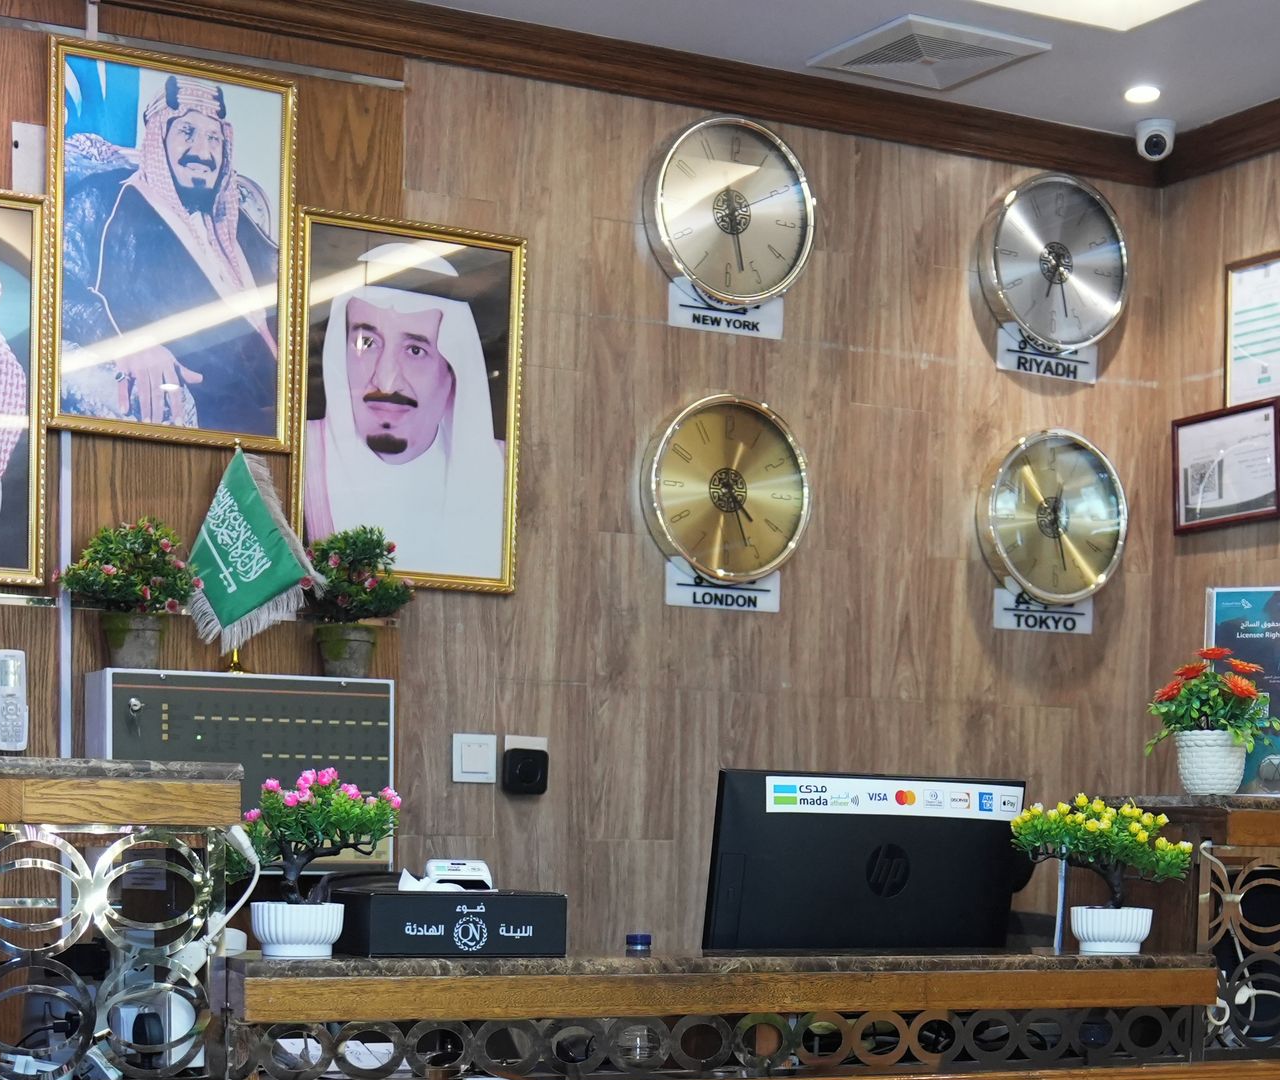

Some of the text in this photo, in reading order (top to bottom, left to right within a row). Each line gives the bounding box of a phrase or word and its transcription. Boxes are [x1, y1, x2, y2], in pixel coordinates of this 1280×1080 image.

[692, 313, 760, 332] NEW YORK
[1017, 356, 1078, 380] RIYADH
[693, 591, 757, 609] LONDON
[1014, 613, 1076, 631] TOKYO
[1240, 620, 1259, 630] السائح
[1237, 631, 1264, 639] Licensee
[799, 785, 827, 793] مدى
[799, 796, 828, 806] mada
[868, 793, 888, 801] VISA
[1007, 800, 1016, 808] Pay
[456, 903, 485, 914] ضوء
[405, 922, 445, 936] الهادئة
[459, 924, 482, 945] QN
[499, 923, 533, 939] الليلة
